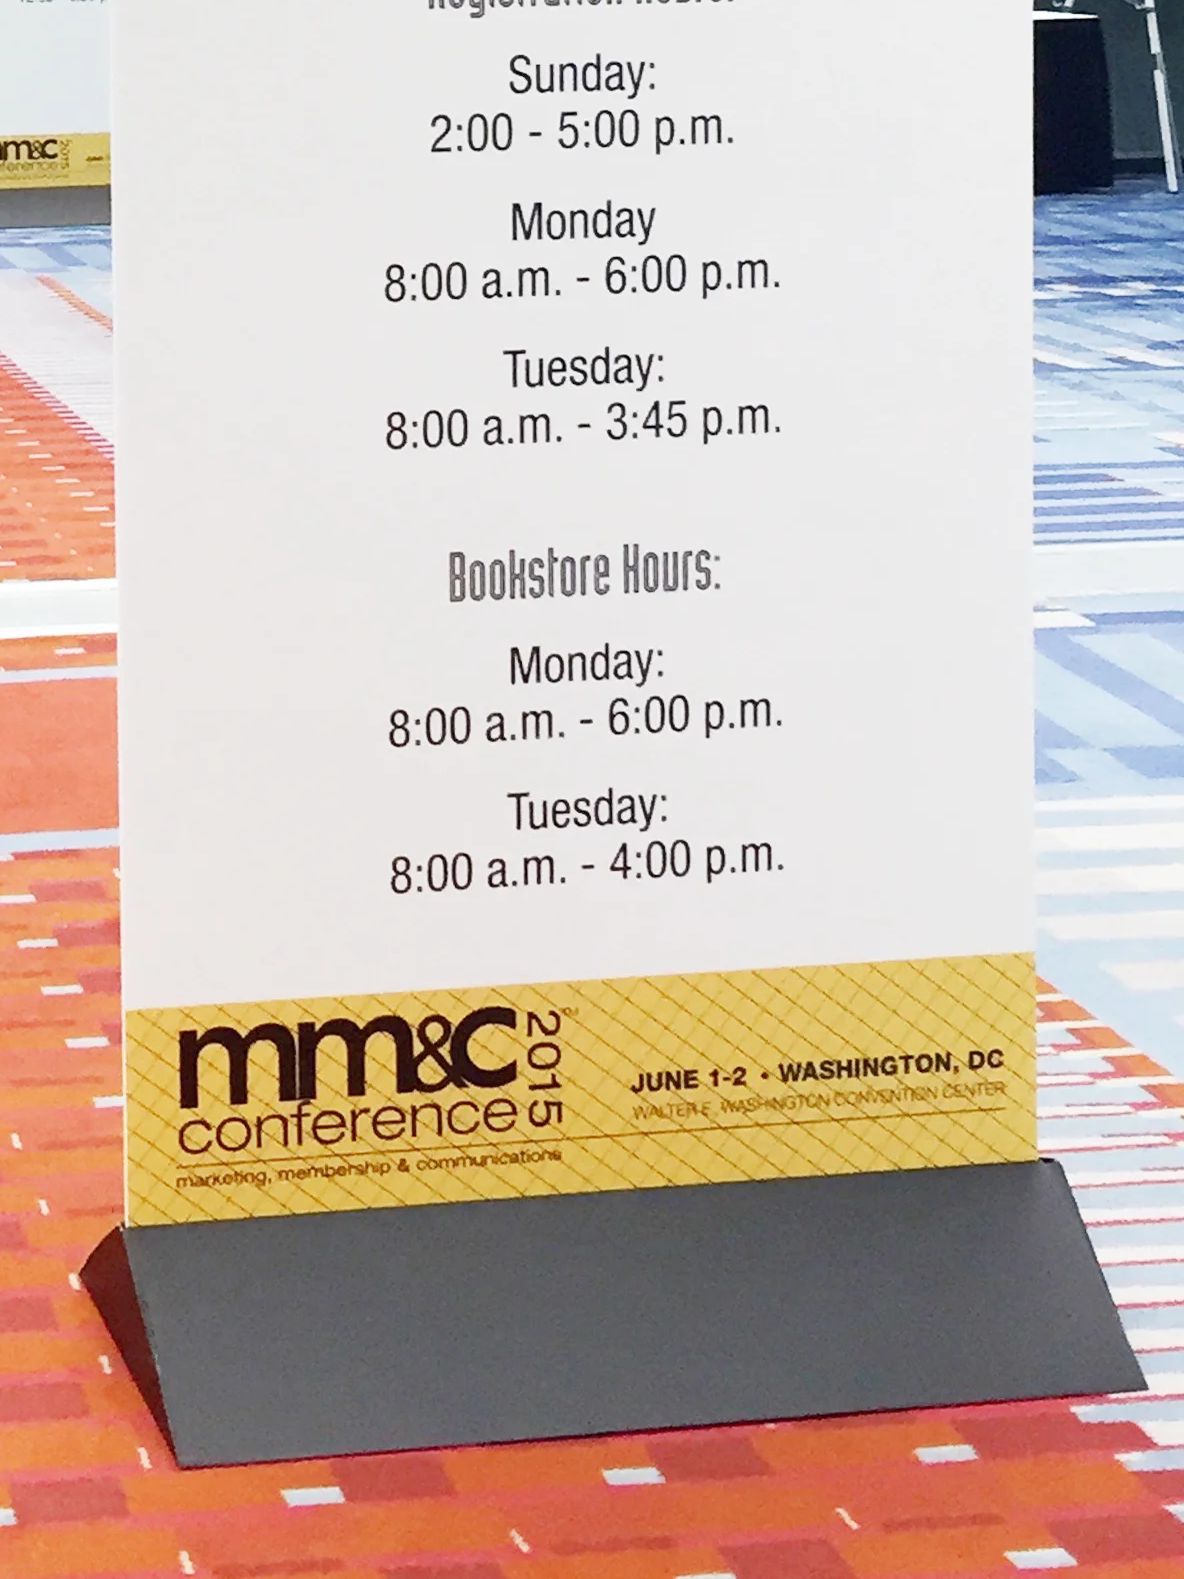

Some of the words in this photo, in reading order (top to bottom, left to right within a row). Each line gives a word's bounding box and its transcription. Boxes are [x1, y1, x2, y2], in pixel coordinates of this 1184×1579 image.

[508, 54, 656, 99] Sunday:
[430, 113, 513, 153] 2:00
[558, 109, 640, 149] 5:00
[654, 113, 734, 155] p.m.
[511, 200, 656, 246] Monday
[384, 262, 467, 302] 8:00
[481, 265, 562, 299] a.m.
[605, 254, 687, 295] 6:00
[701, 258, 781, 299] p.m.
[503, 347, 665, 392] Tuesday:
[385, 409, 469, 450] 8:00
[483, 412, 563, 446] a.m.
[606, 400, 688, 441] 3:45
[702, 403, 782, 445] p.m.
[449, 547, 610, 603] Bookstore
[623, 544, 721, 594] Hours:
[510, 643, 664, 687] Monday:
[388, 706, 472, 748] 8:00
[485, 709, 565, 743] a.m.
[608, 695, 690, 735] 6:00
[704, 697, 783, 738] p.m.
[507, 788, 668, 832] Tuesday:
[390, 852, 473, 894] 8:00
[487, 854, 567, 888] a.m.
[609, 839, 691, 880] 4:00
[706, 841, 784, 883] p.m.
[526, 1010, 563, 1128] 2015
[631, 1069, 699, 1094] JUNE
[709, 1067, 747, 1087] 1-2
[779, 1051, 959, 1082] WASHINGTON,
[969, 1049, 1004, 1070] DC
[632, 1101, 696, 1120] WALTER
[720, 1093, 830, 1114] WASHINGTON
[834, 1086, 938, 1106] CONVENTION
[942, 1081, 1008, 1099] CENTER
[178, 1097, 517, 1155] conference
[175, 1169, 272, 1189] marketing,
[277, 1160, 391, 1182] membership
[397, 1157, 410, 1173] &
[416, 1148, 563, 1171] communications
